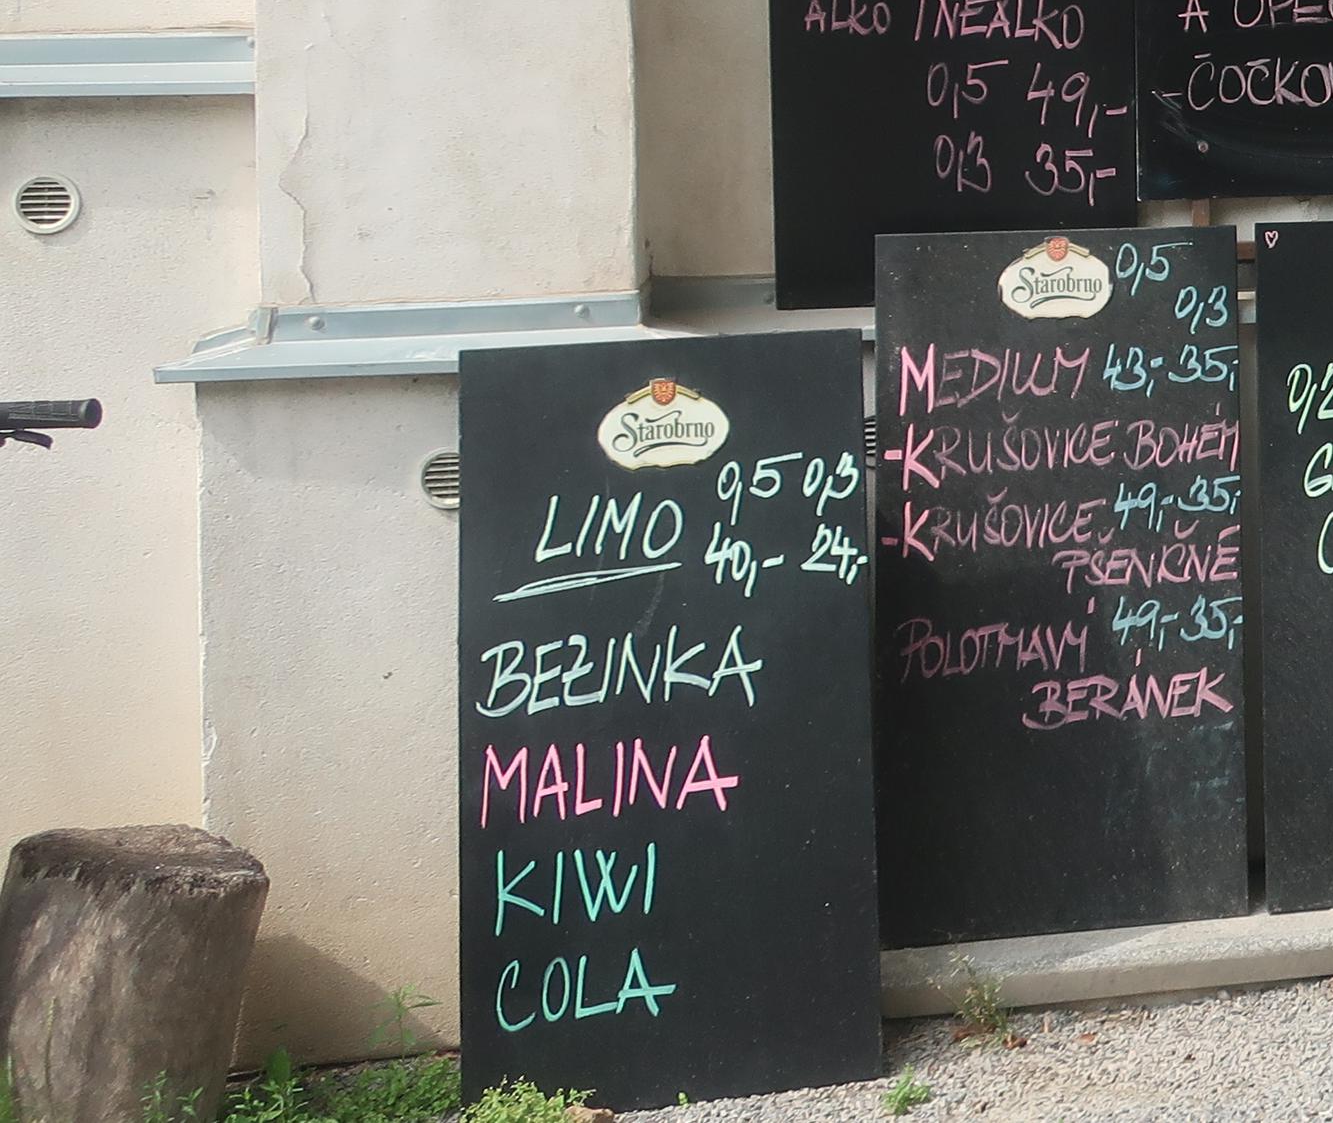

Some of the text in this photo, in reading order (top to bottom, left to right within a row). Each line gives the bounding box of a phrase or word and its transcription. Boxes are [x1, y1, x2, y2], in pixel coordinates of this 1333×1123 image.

[927, 59, 1009, 119] 0,5
[1011, 266, 1102, 309] Starobrno
[1115, 241, 1194, 296] 0,5
[1174, 285, 1228, 334] 0,3
[899, 343, 1091, 416] MEDIUM
[612, 410, 714, 458] Starobrno
[535, 491, 684, 563] LIMO
[481, 734, 739, 829] MALINA
[496, 842, 656, 936] KIWI
[496, 948, 677, 1032] COLA
